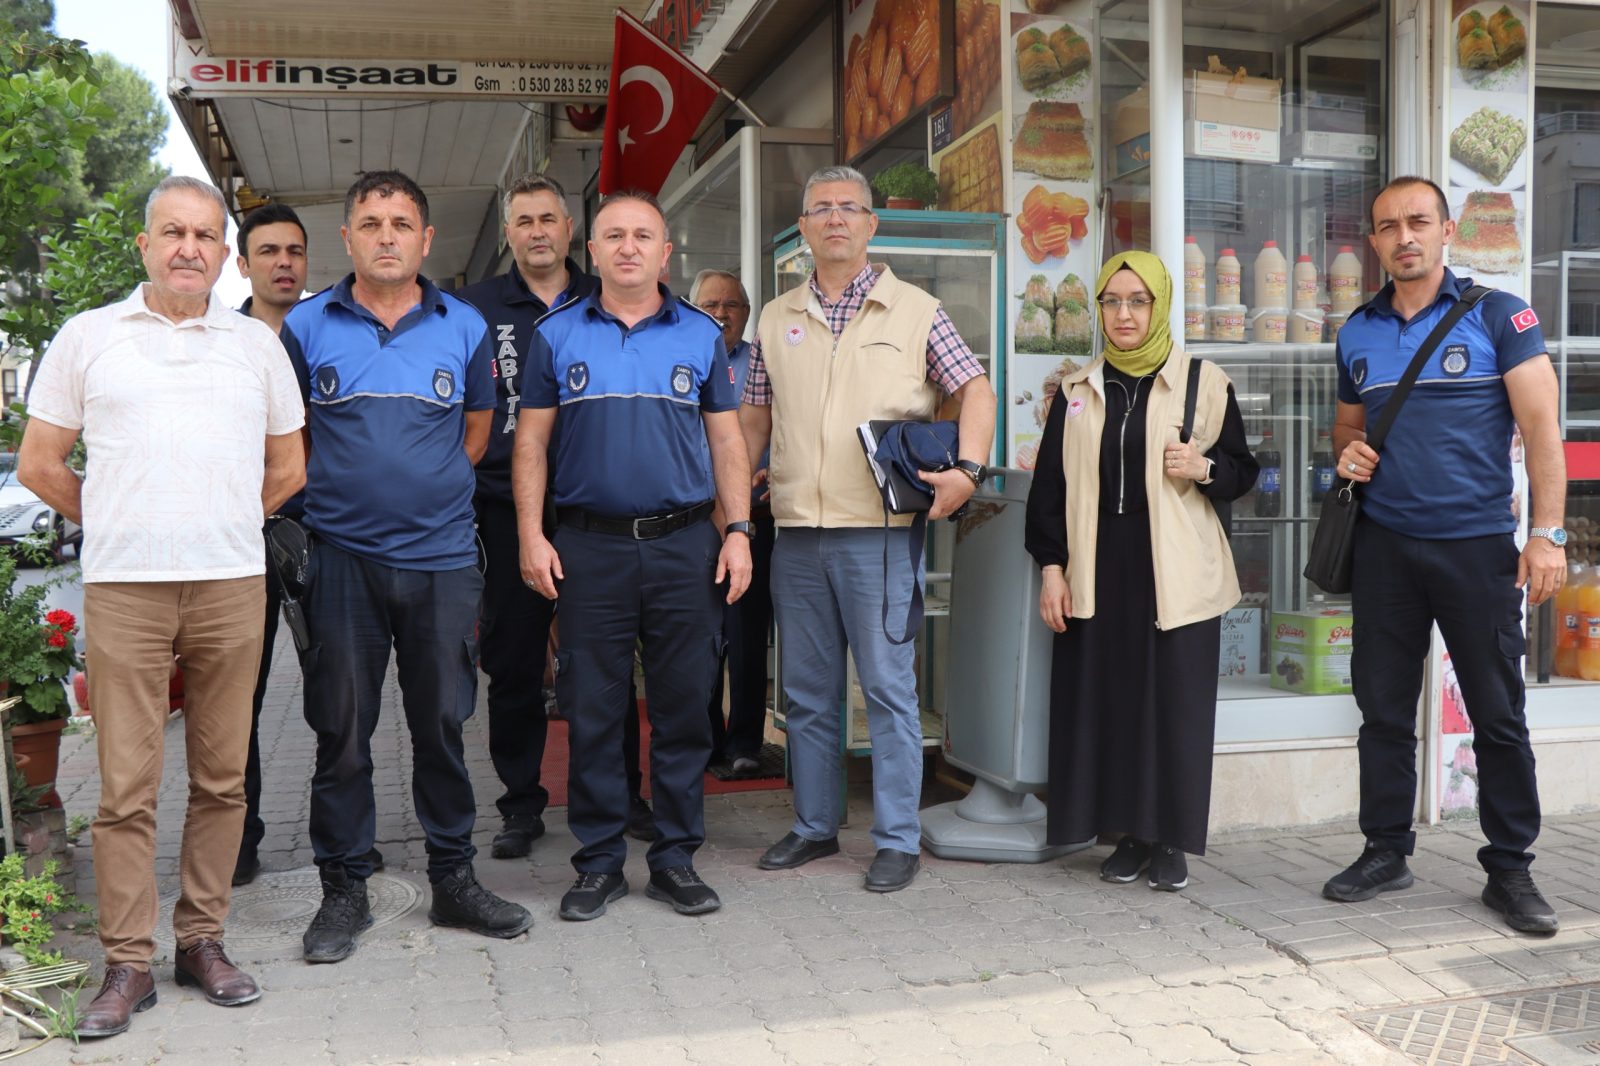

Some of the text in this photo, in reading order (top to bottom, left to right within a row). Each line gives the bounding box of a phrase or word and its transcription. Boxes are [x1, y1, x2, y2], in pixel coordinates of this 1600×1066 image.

[474, 75, 500, 91] Gsm
[518, 76, 527, 92] 0
[529, 77, 551, 92] 530
[554, 78, 575, 93] 283
[578, 78, 592, 94] 52
[595, 79, 609, 94] 99
[934, 116, 945, 138] 161
[496, 324, 521, 434] ZABITA
